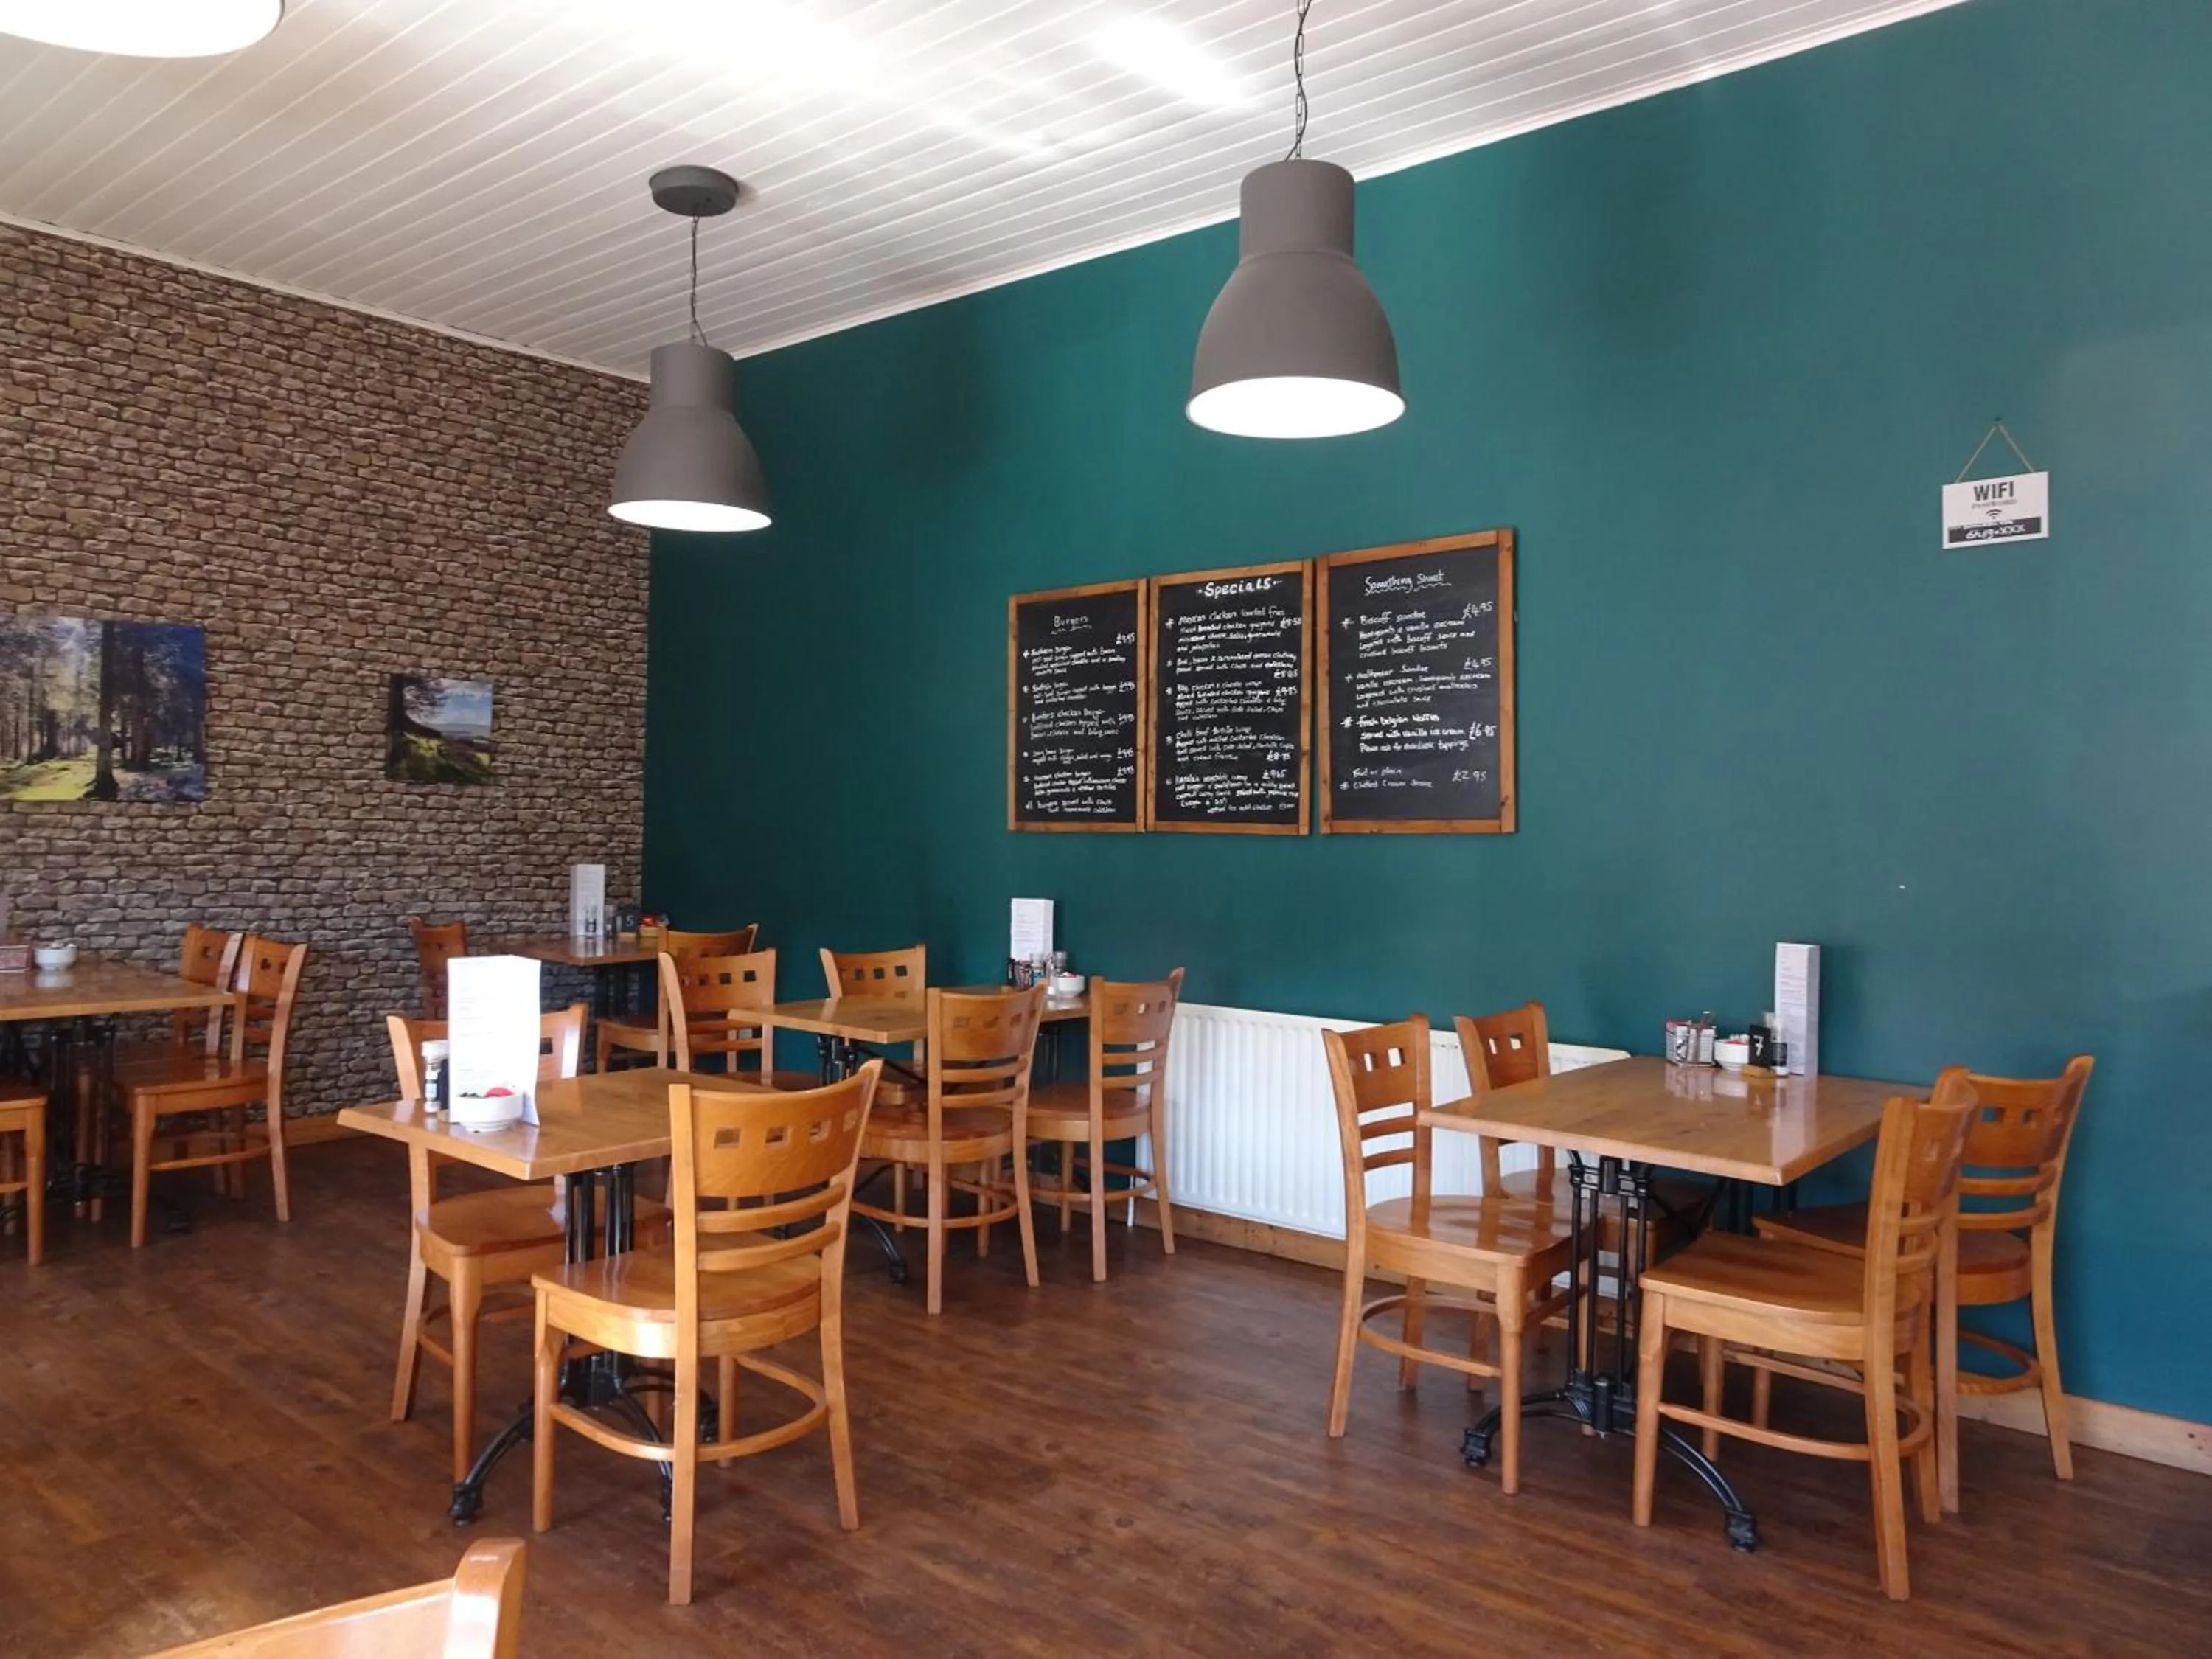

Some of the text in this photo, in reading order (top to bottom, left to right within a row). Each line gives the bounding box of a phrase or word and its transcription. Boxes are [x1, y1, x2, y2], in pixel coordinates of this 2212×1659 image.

[1973, 481, 2014, 501] WIFI
[1364, 575, 1413, 597] Something
[1054, 615, 1088, 627] Burgers
[1360, 611, 1392, 626] Biscoff
[626, 914, 634, 927] 5
[1753, 1035, 1764, 1057] 7
